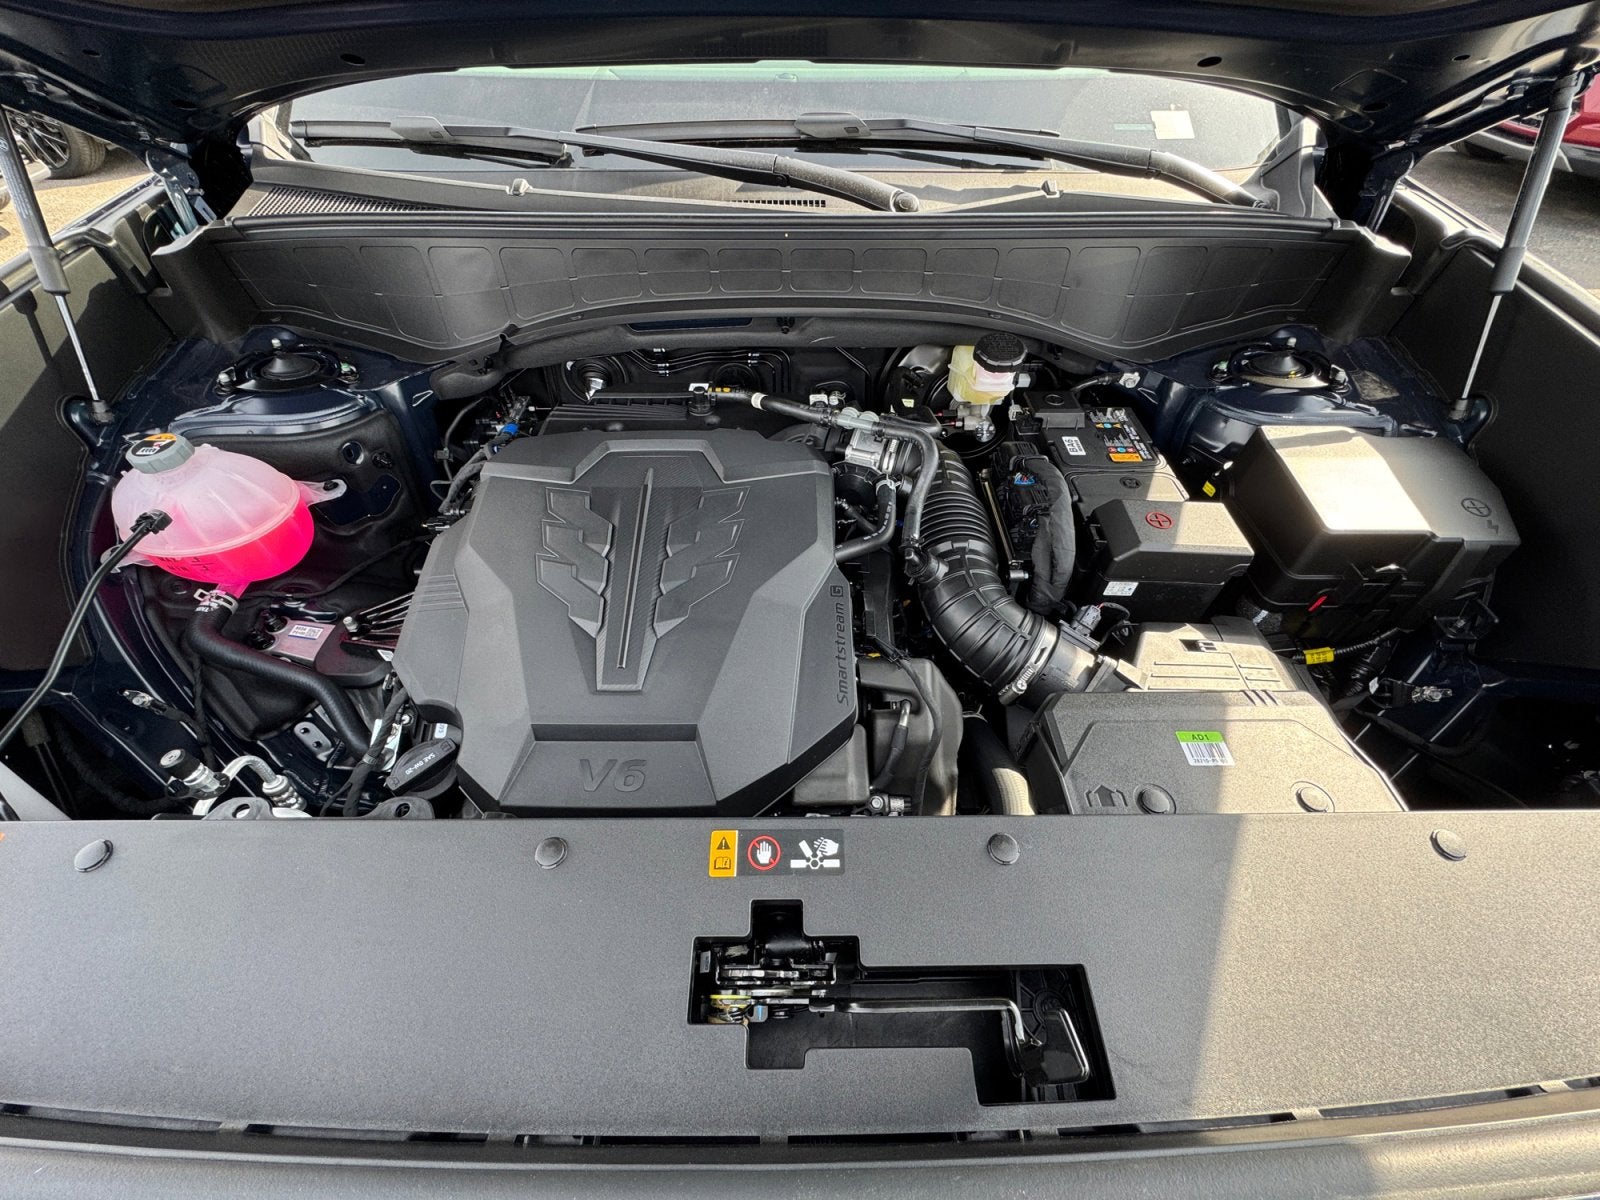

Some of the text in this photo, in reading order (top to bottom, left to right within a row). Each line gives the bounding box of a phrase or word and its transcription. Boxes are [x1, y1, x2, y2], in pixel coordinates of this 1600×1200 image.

[835, 602, 849, 706] Smartstream
[423, 752, 436, 763] SAE
[579, 758, 647, 792] V6
